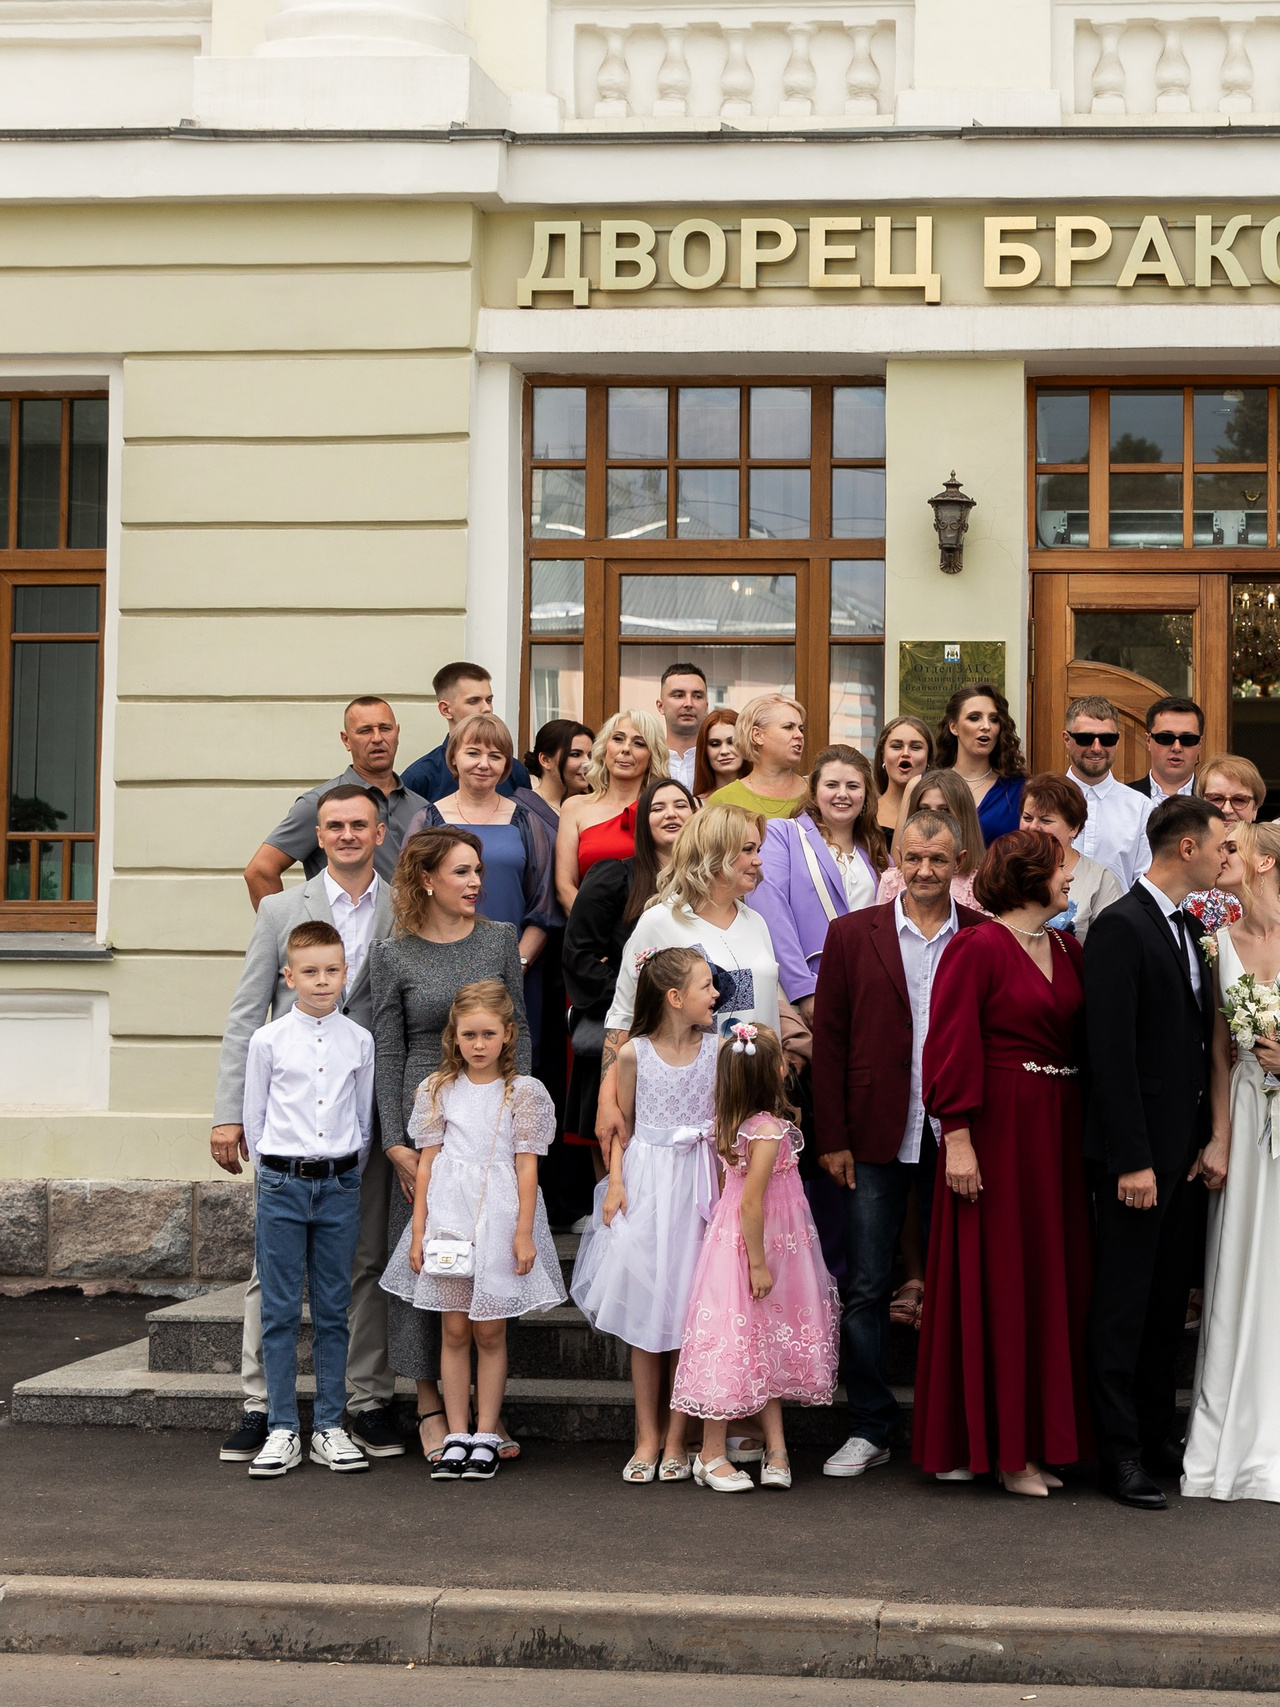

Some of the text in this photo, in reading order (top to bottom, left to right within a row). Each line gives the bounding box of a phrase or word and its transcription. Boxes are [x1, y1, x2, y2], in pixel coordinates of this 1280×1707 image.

[517, 216, 942, 308] ДВОРЕЦ
[914, 664, 992, 674] Отдел ЗАГС
[905, 684, 948, 692] Великого
